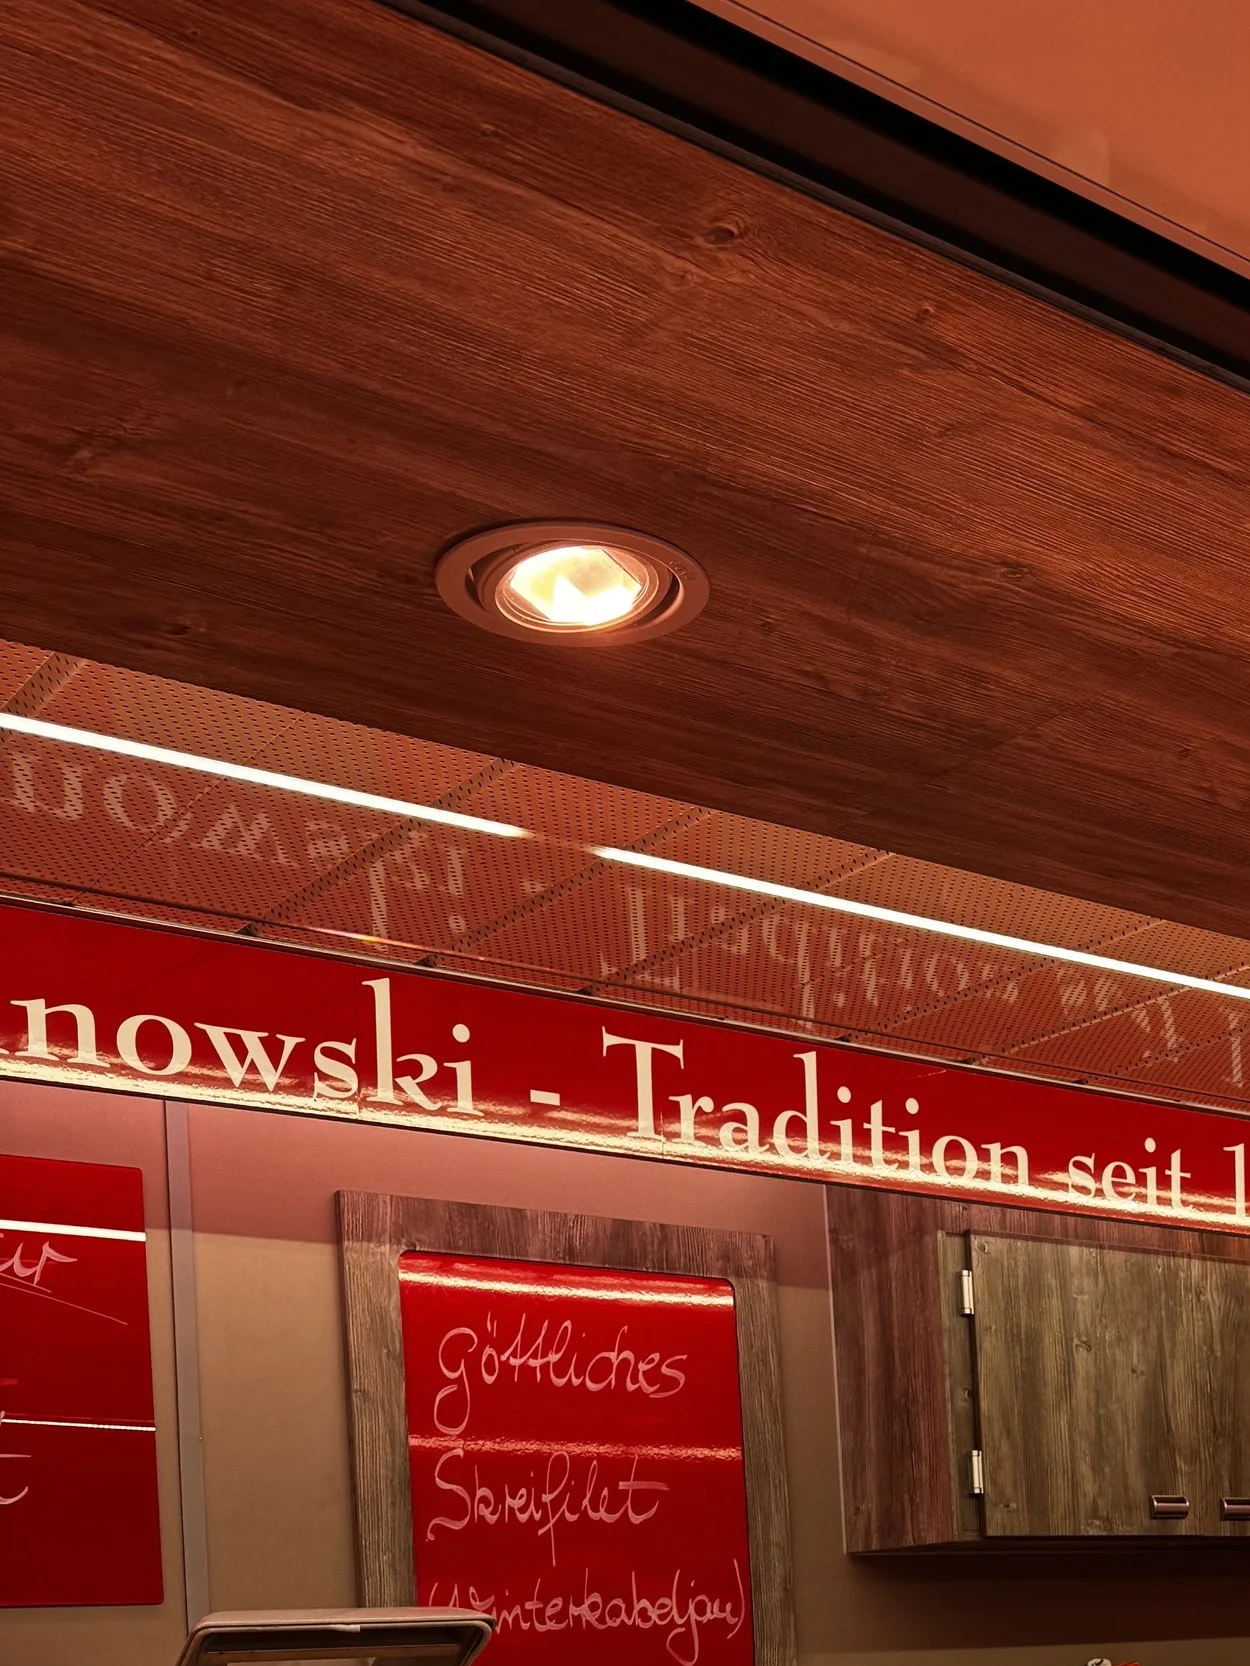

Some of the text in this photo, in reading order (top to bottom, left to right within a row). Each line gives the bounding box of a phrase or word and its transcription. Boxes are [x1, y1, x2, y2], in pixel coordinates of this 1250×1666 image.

[602, 1026, 1031, 1187] Tradition
[1067, 1137, 1193, 1211] seit
[434, 1311, 688, 1436] Göttliches
[427, 1449, 670, 1567] Skreifilet
